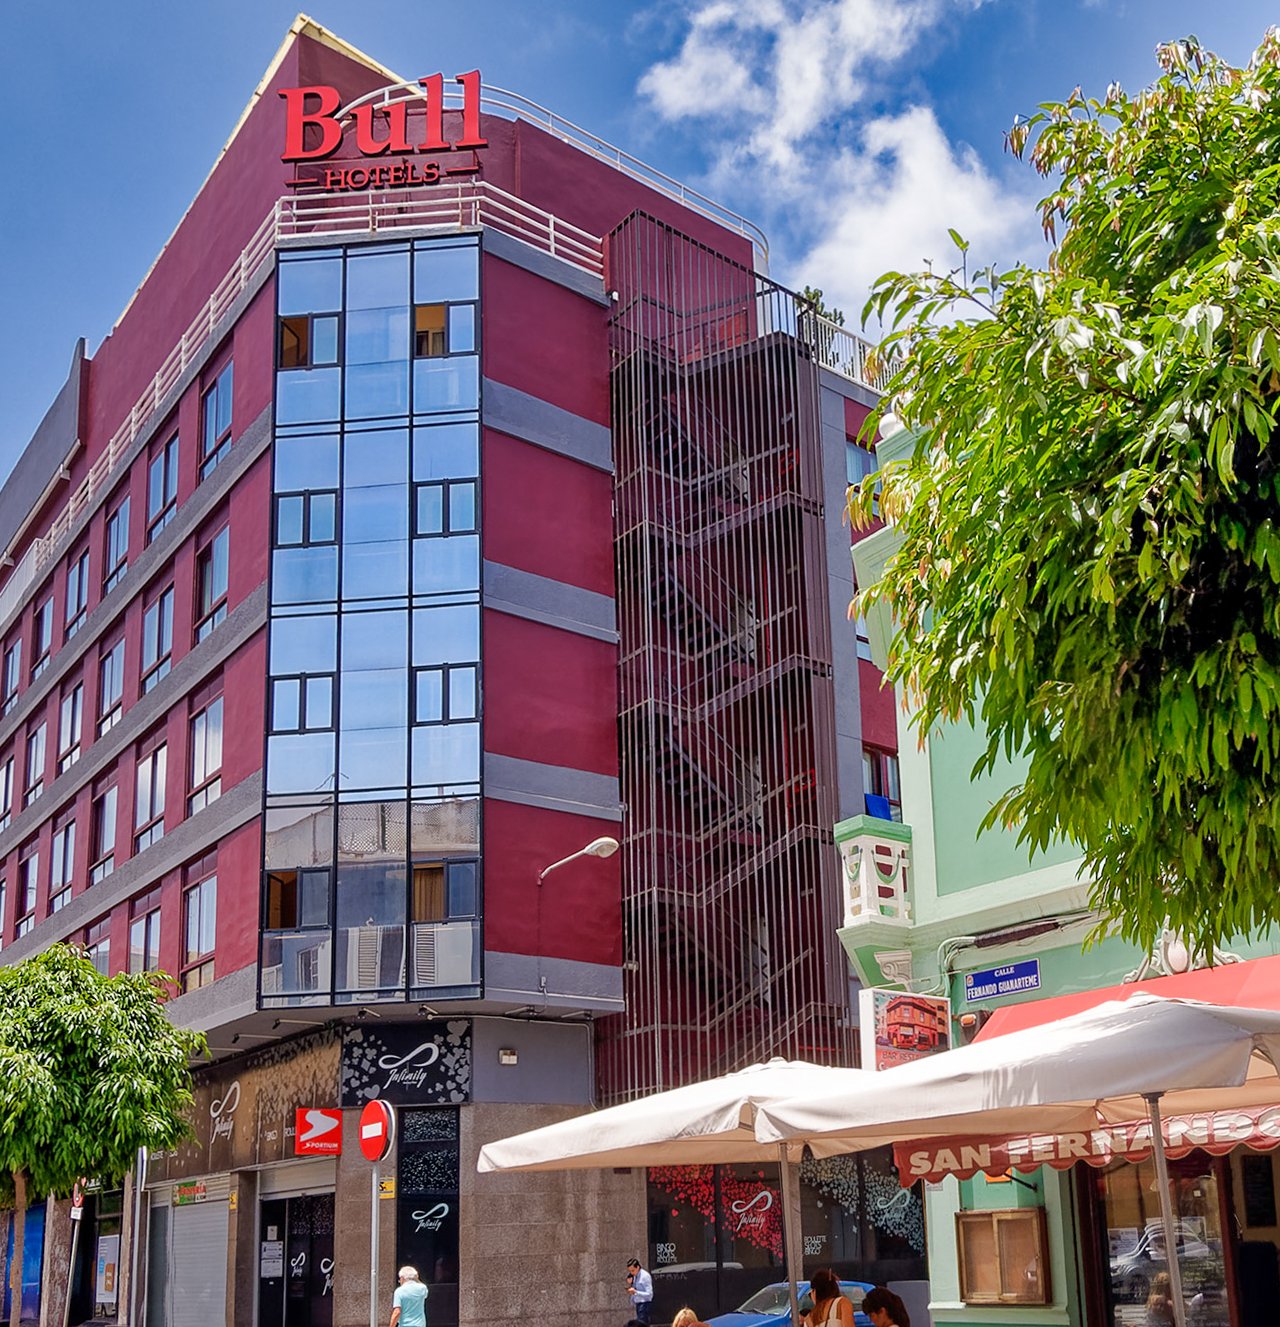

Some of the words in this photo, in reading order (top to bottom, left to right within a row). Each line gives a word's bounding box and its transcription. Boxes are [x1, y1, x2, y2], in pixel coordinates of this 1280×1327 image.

[278, 69, 489, 162] Bull
[324, 160, 440, 191] HOTELS
[994, 966, 1015, 978] CALLE
[967, 982, 998, 999] FERNANDO
[998, 974, 1038, 993] GUANARTEME
[882, 1051, 897, 1061] BAR
[302, 1140, 339, 1150] SPORTIUM
[908, 1143, 991, 1175] SAN
